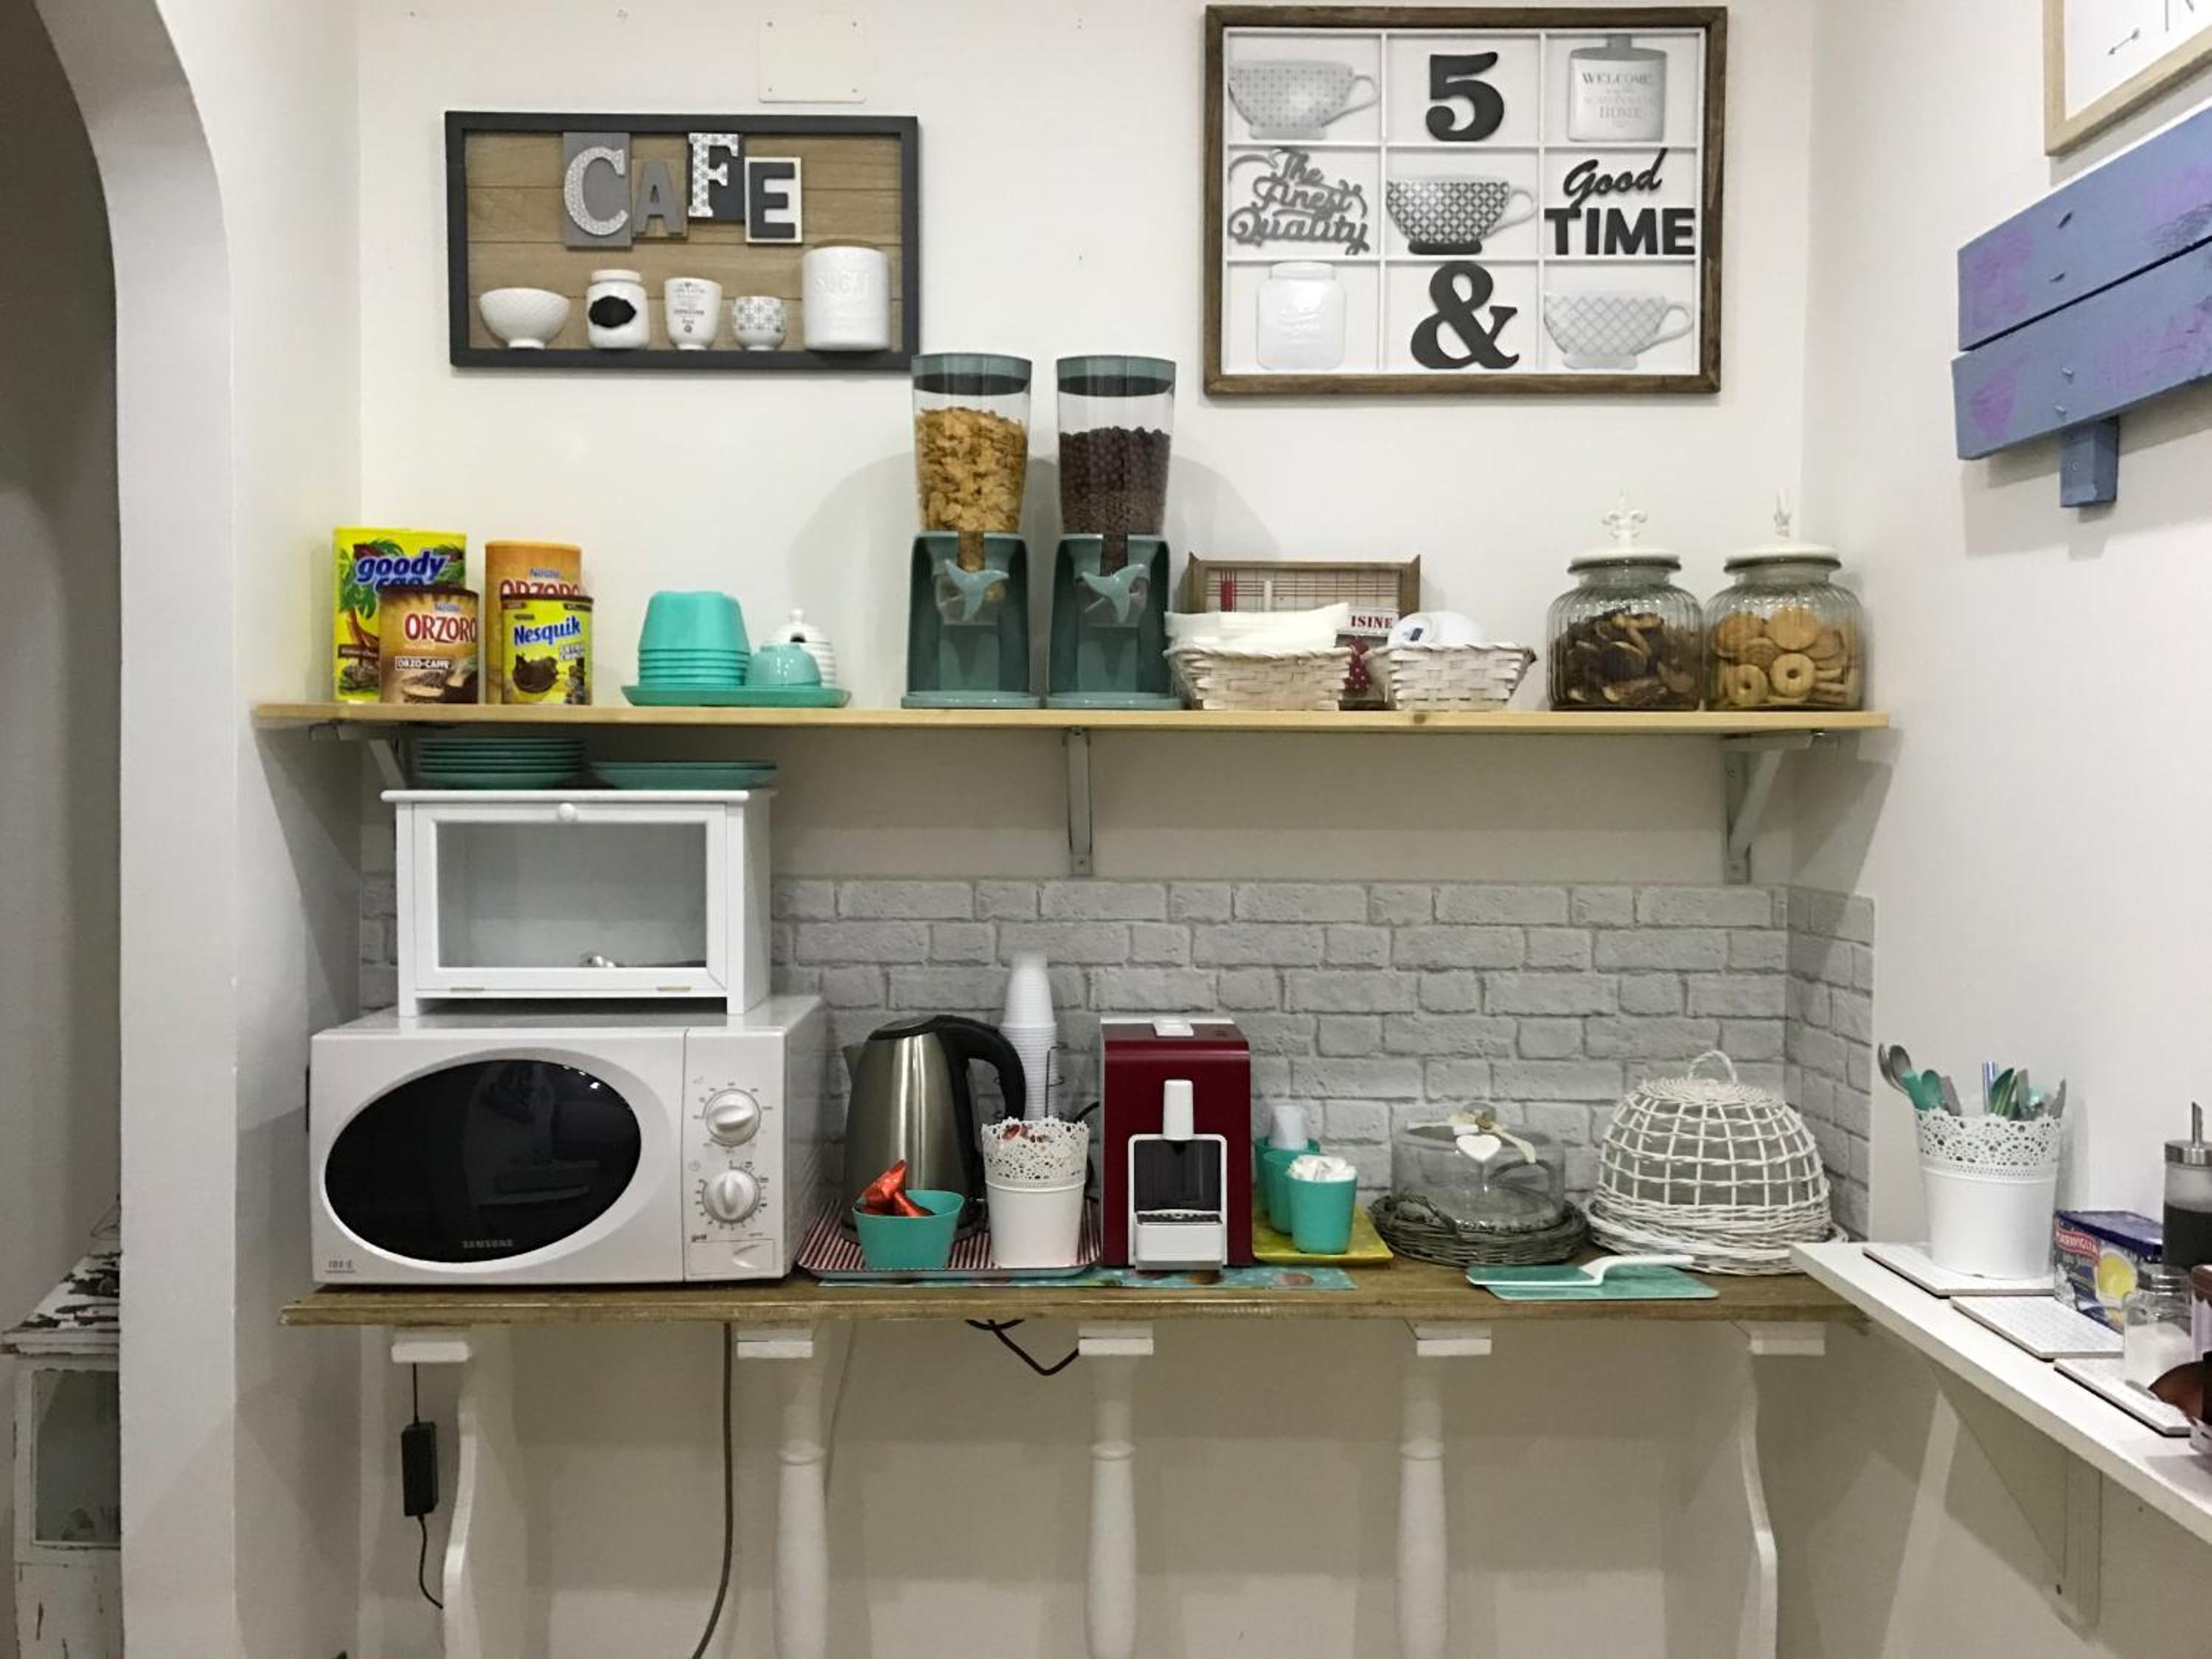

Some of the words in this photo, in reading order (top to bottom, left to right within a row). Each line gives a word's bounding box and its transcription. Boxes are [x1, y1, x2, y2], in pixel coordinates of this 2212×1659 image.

[1426, 52, 1504, 142] 5
[564, 133, 796, 238] CAFE
[1268, 146, 1324, 184] The
[1563, 147, 1668, 209] Good
[1253, 177, 1366, 217] Finest
[1228, 203, 1370, 255] Quality
[1544, 207, 1696, 255] TIME
[1410, 260, 1520, 369] &
[355, 549, 447, 582] goody
[404, 613, 478, 643] ORZORO
[514, 615, 581, 646] Nesquik
[1351, 615, 1394, 628] ISINE
